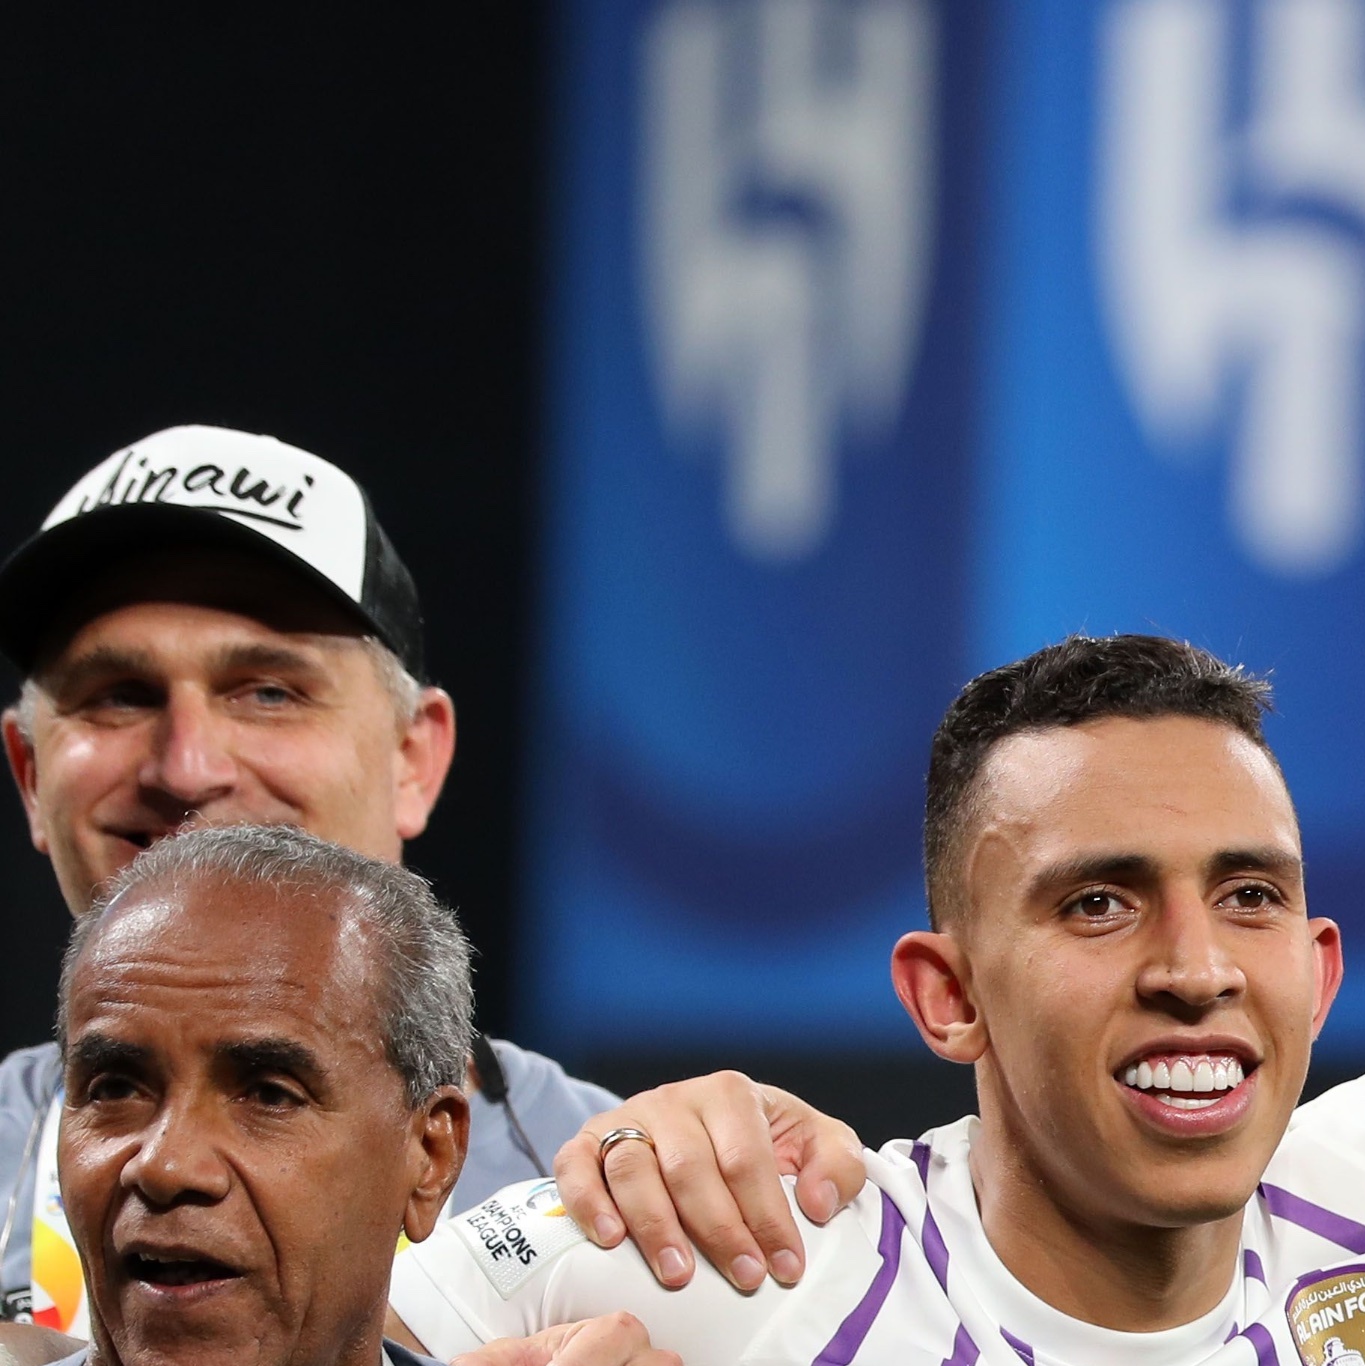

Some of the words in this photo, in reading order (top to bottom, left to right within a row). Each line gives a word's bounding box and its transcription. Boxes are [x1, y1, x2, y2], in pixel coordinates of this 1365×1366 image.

[467, 1213, 510, 1261] LEAGUE
[1297, 1321, 1311, 1345] AL
[1309, 1302, 1344, 1335] AIN
